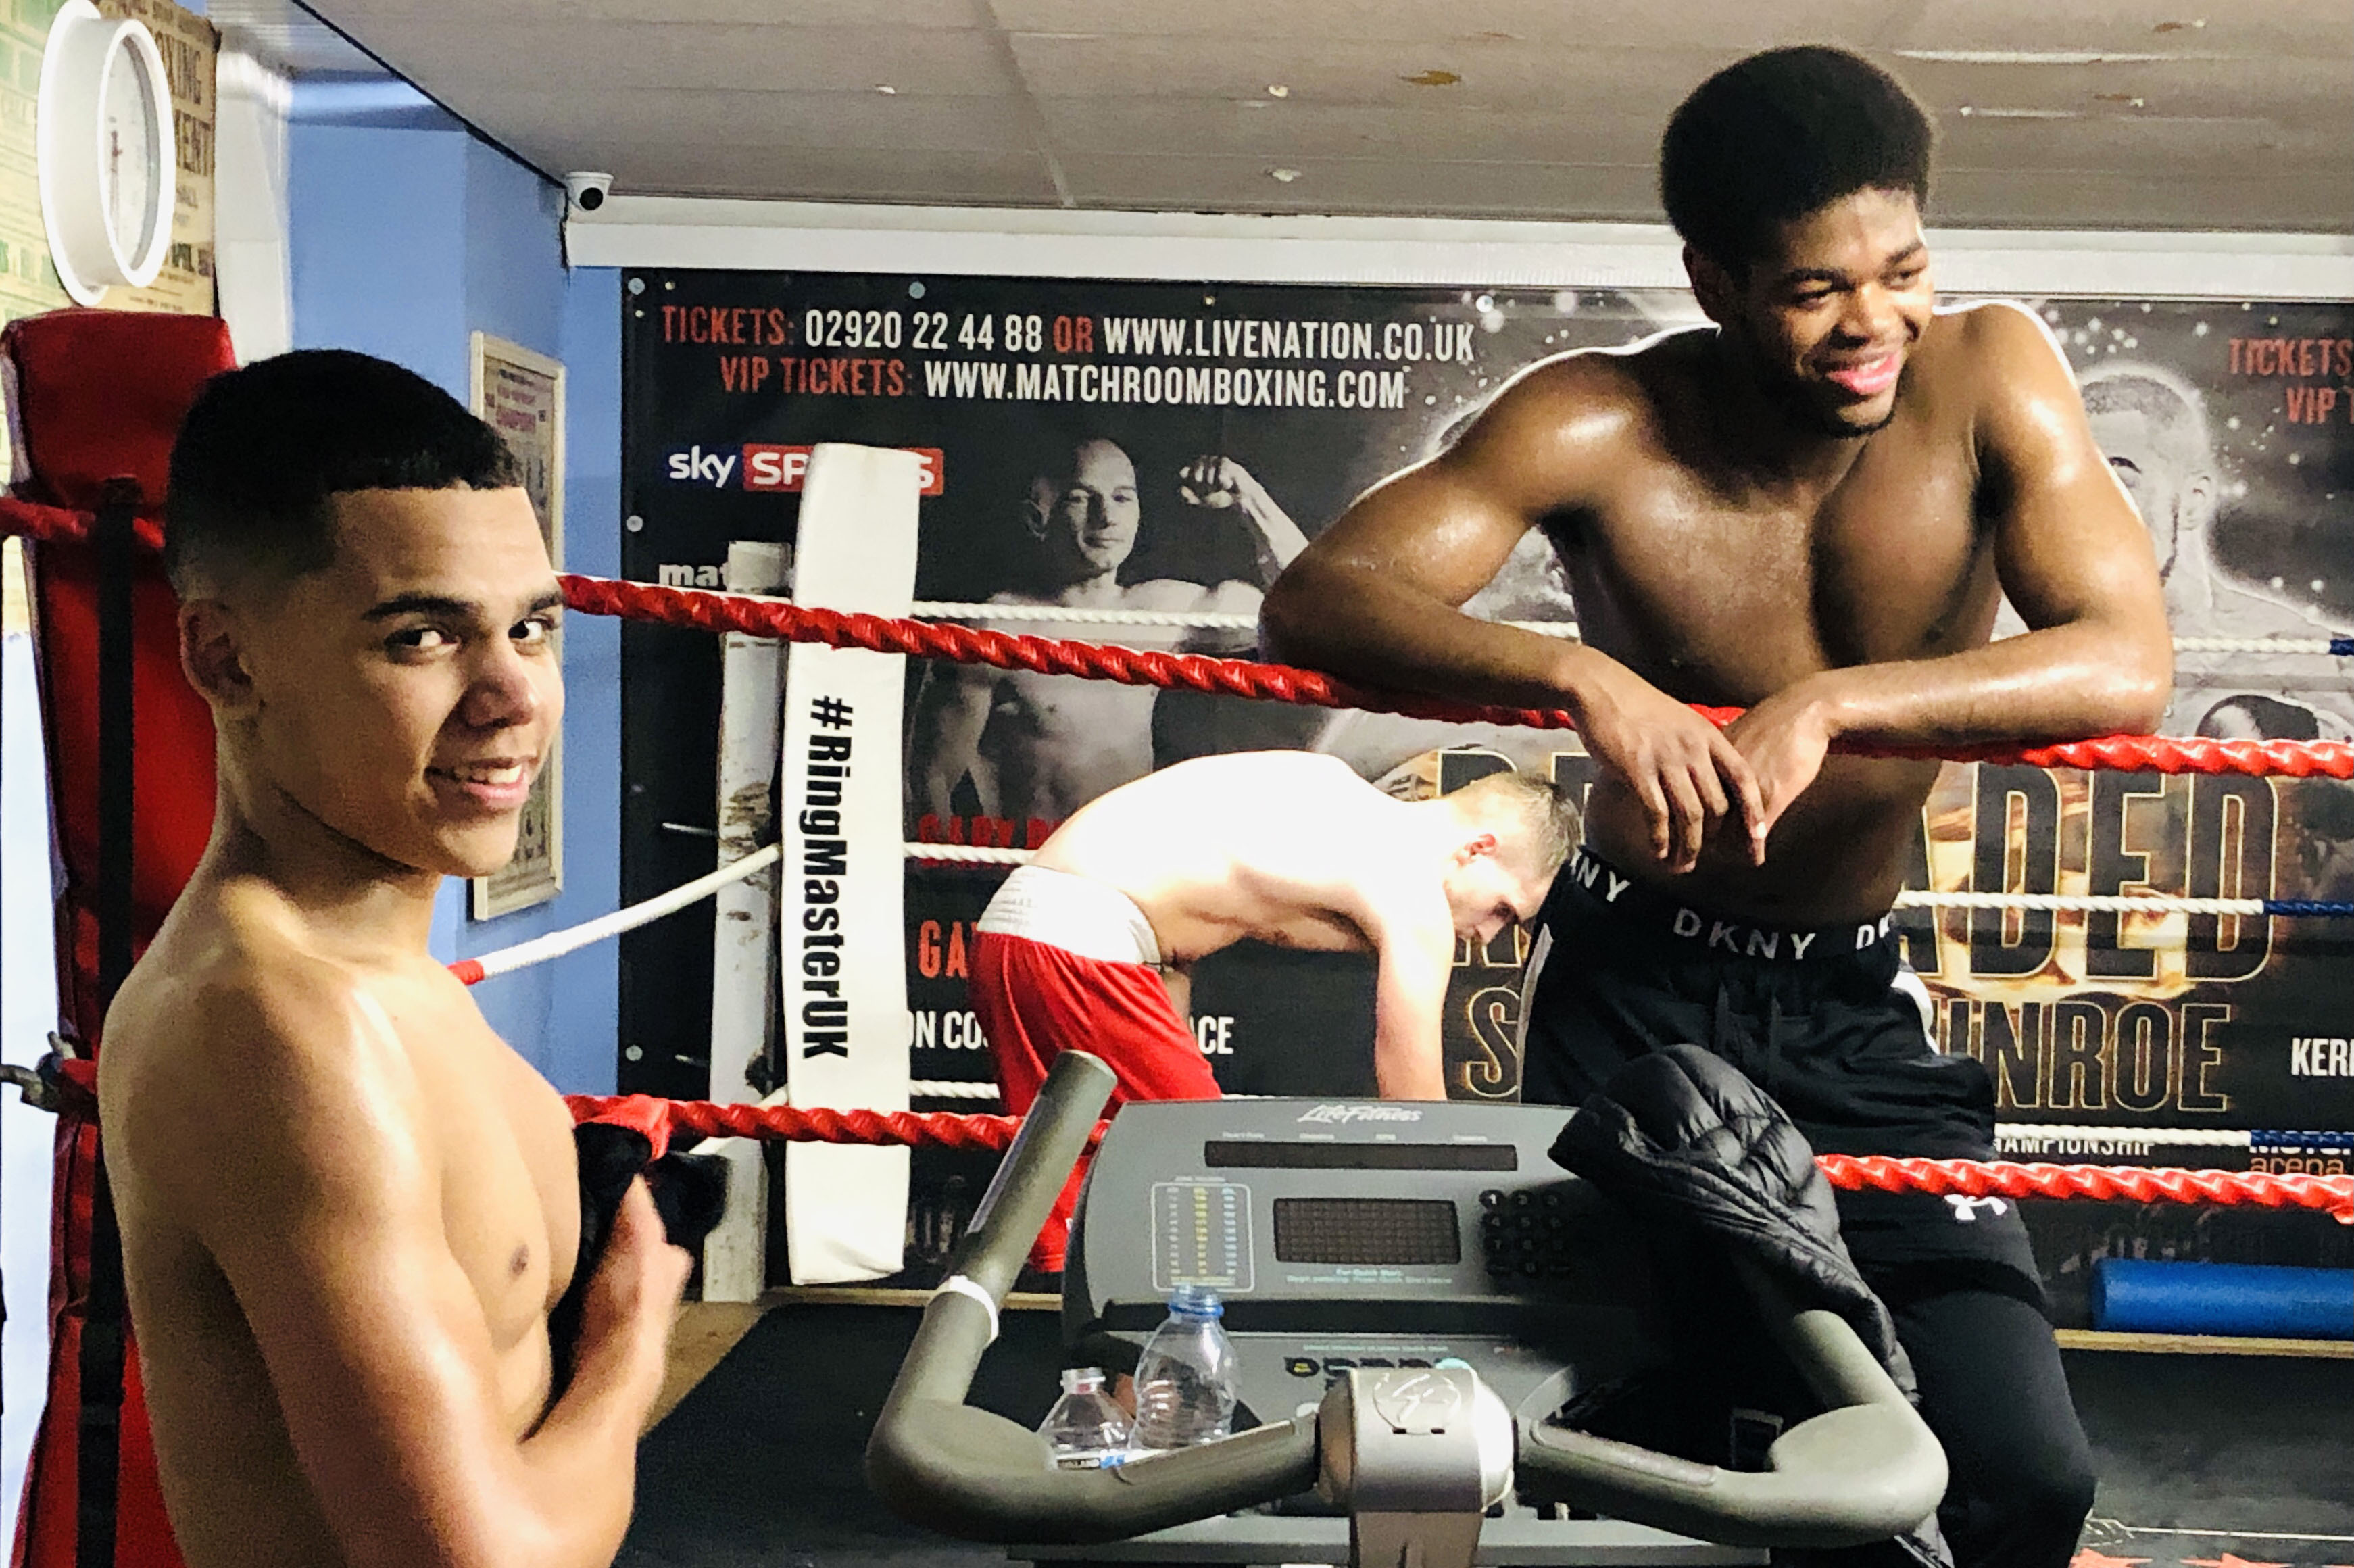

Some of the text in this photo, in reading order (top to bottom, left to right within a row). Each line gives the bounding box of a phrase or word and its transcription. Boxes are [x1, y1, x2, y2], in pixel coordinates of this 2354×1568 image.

[662, 305, 1475, 362] TICKETS: 02920 22 44 88 OR WWW.LIVENATION.CO.UK
[720, 356, 1404, 409] VIP TICKETS: WWW.MATCHROOMBOXING.COM
[2286, 387, 2337, 424] VIP
[668, 445, 737, 488] sky
[799, 694, 854, 1059] #RingMasterUK
[1673, 907, 1817, 960] DKNY
